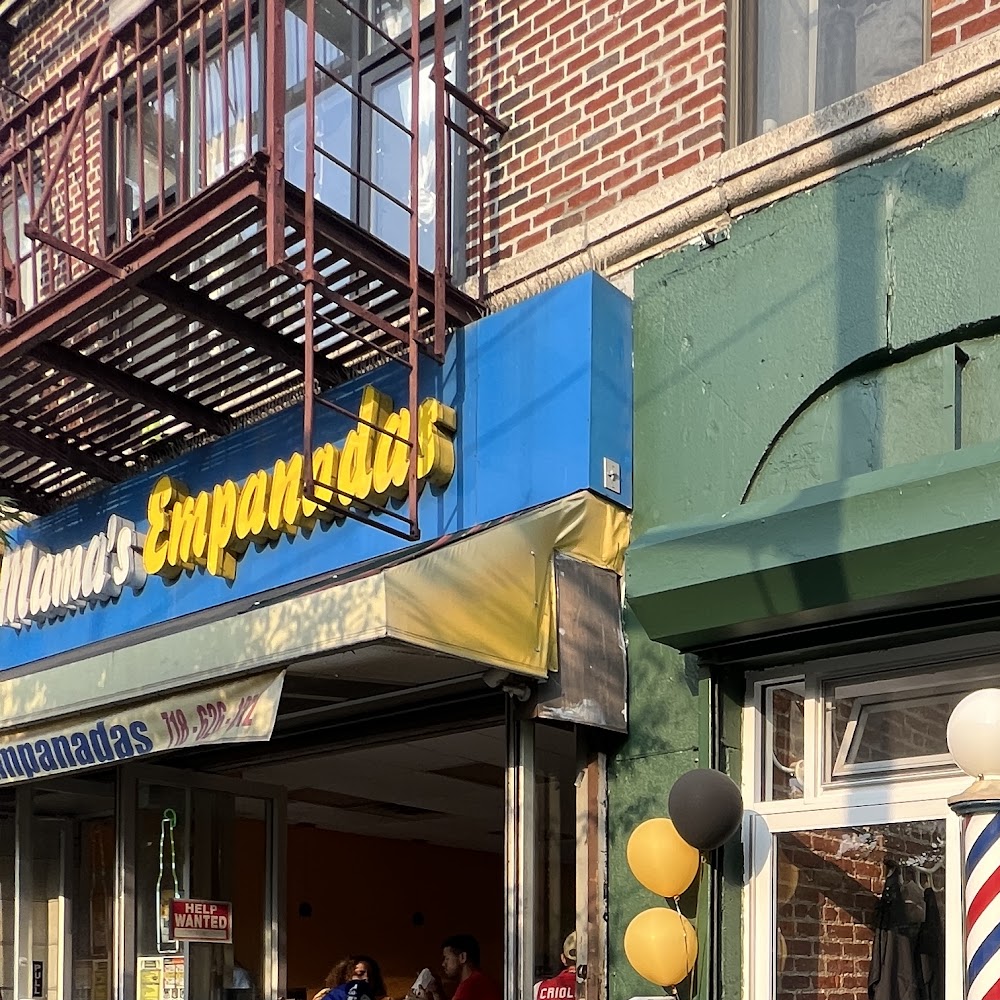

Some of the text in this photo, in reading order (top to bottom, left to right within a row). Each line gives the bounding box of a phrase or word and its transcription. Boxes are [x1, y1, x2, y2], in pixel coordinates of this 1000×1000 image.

[142, 384, 455, 577] Empanadas
[184, 902, 218, 915] HELP
[174, 913, 228, 930] WANTED
[34, 963, 42, 995] PULL
